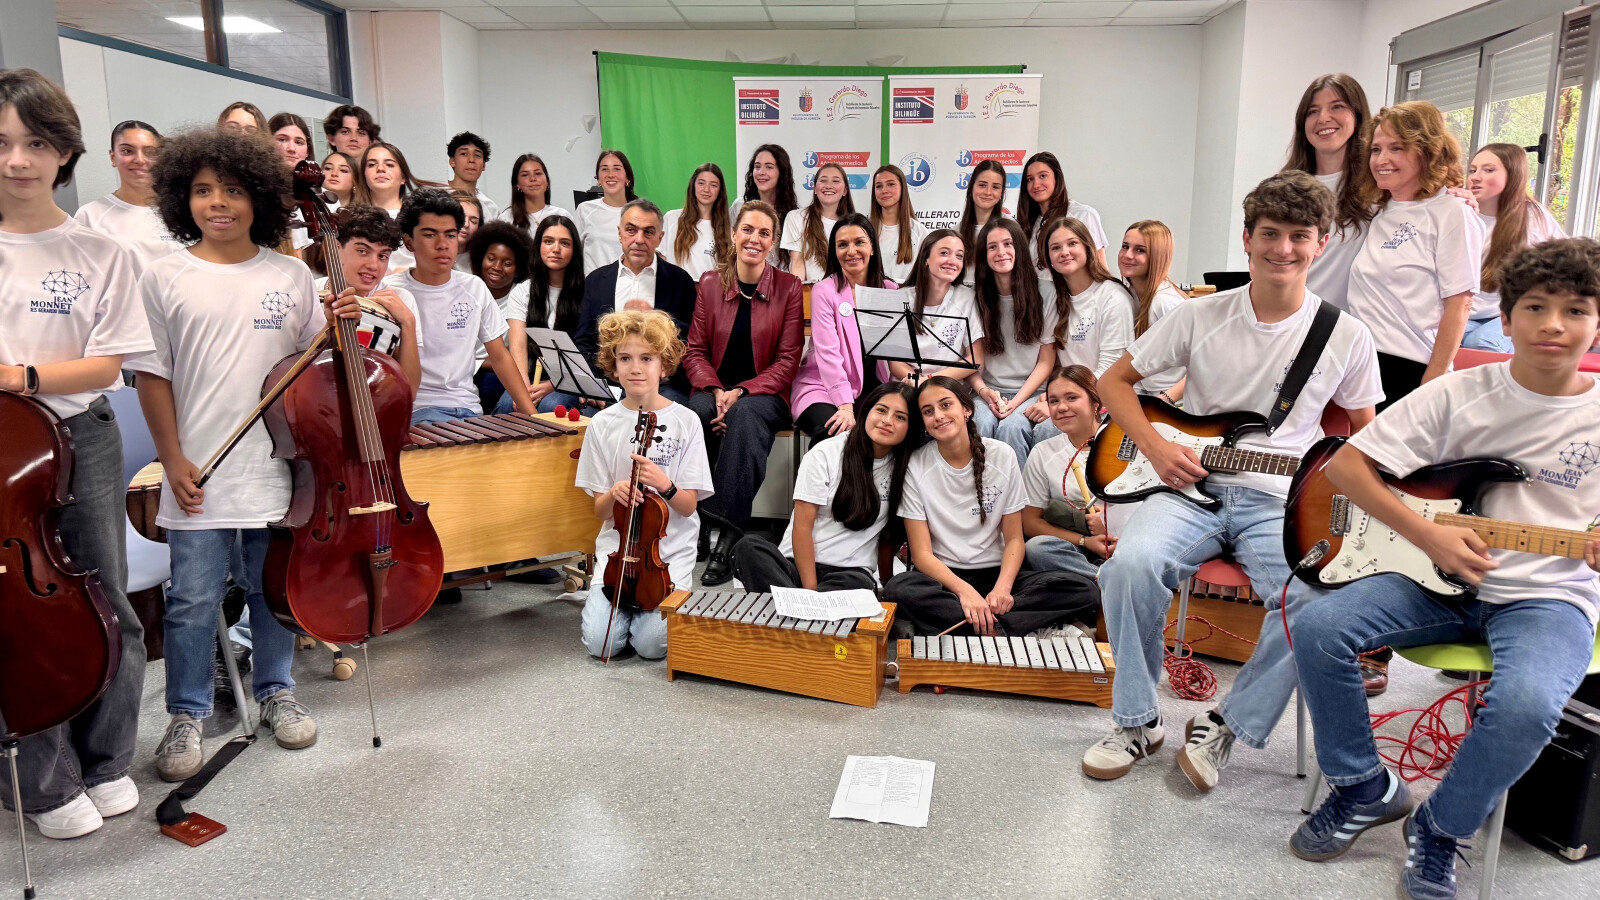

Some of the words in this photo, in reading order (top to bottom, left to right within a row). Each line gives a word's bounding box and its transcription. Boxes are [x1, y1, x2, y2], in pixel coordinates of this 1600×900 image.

[828, 85, 851, 103] Gerardo
[851, 85, 868, 98] Diego
[985, 82, 1008, 102] Gerardo
[1008, 82, 1025, 95] Diego
[820, 153, 845, 161] Programa
[975, 152, 999, 160] Programa
[31, 300, 73, 310] MONNET
[253, 318, 283, 326] MONNET
[1538, 468, 1582, 485] MONNET
[1564, 468, 1583, 478] JEAN
